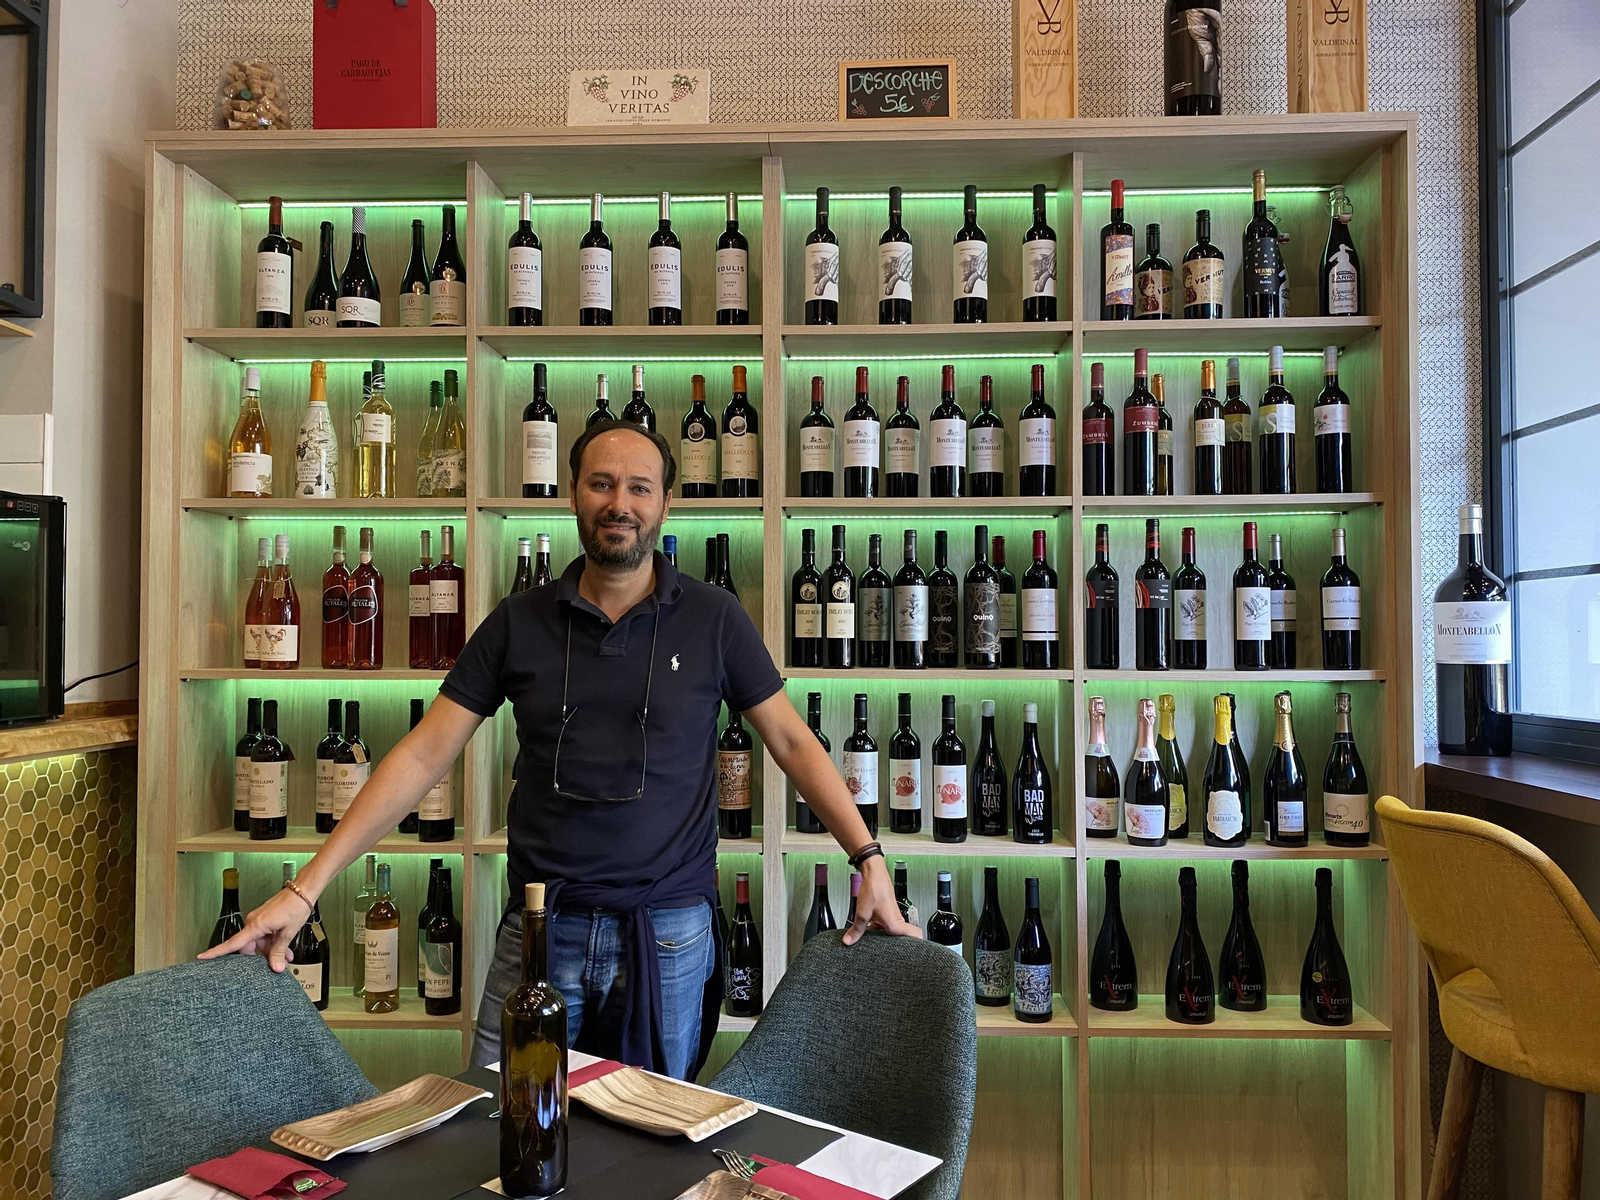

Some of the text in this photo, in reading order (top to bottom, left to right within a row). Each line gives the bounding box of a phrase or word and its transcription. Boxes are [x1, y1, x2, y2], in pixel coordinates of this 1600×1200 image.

[1313, 38, 1360, 46] VALDRINAL
[351, 59, 380, 68] PAGO DE
[340, 69, 391, 78] CARRAOVEJAS
[632, 75, 648, 86] IN
[620, 89, 659, 100] VINO
[609, 102, 670, 114] VERITAS
[880, 93, 914, 113] 5€
[510, 263, 539, 272] EDULIS
[581, 264, 609, 272] EDULIS
[650, 263, 679, 271] EDULIS
[717, 265, 745, 273] EDULIS
[341, 305, 365, 316] SQR
[308, 316, 330, 327] SQR
[982, 783, 1001, 796] BAD
[1024, 790, 1044, 803] BAD
[433, 978, 450, 986] PEPE
